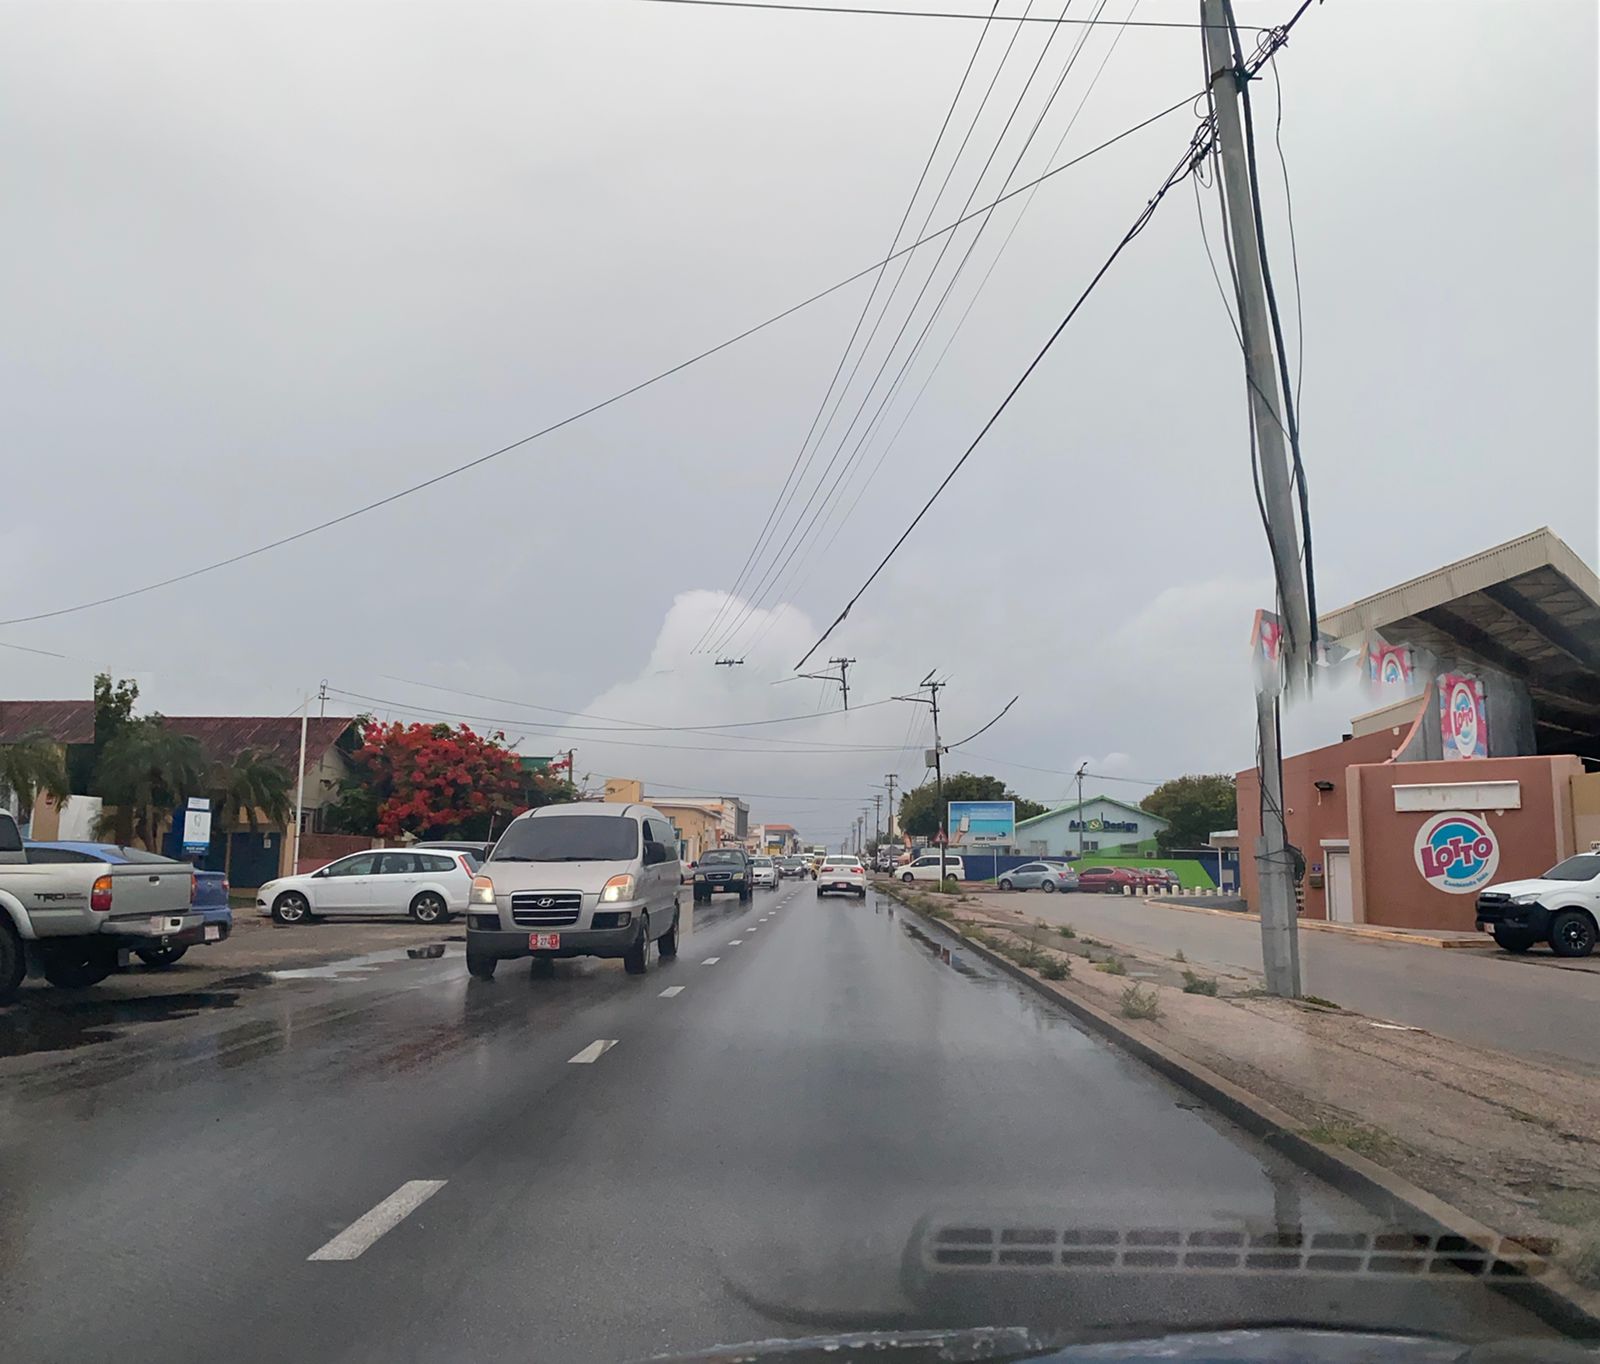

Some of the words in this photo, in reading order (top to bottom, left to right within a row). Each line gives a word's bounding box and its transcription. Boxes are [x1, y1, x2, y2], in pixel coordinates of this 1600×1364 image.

[1103, 820, 1138, 832] Design
[1420, 836, 1494, 879] LOTTO
[34, 892, 66, 903] TRD
